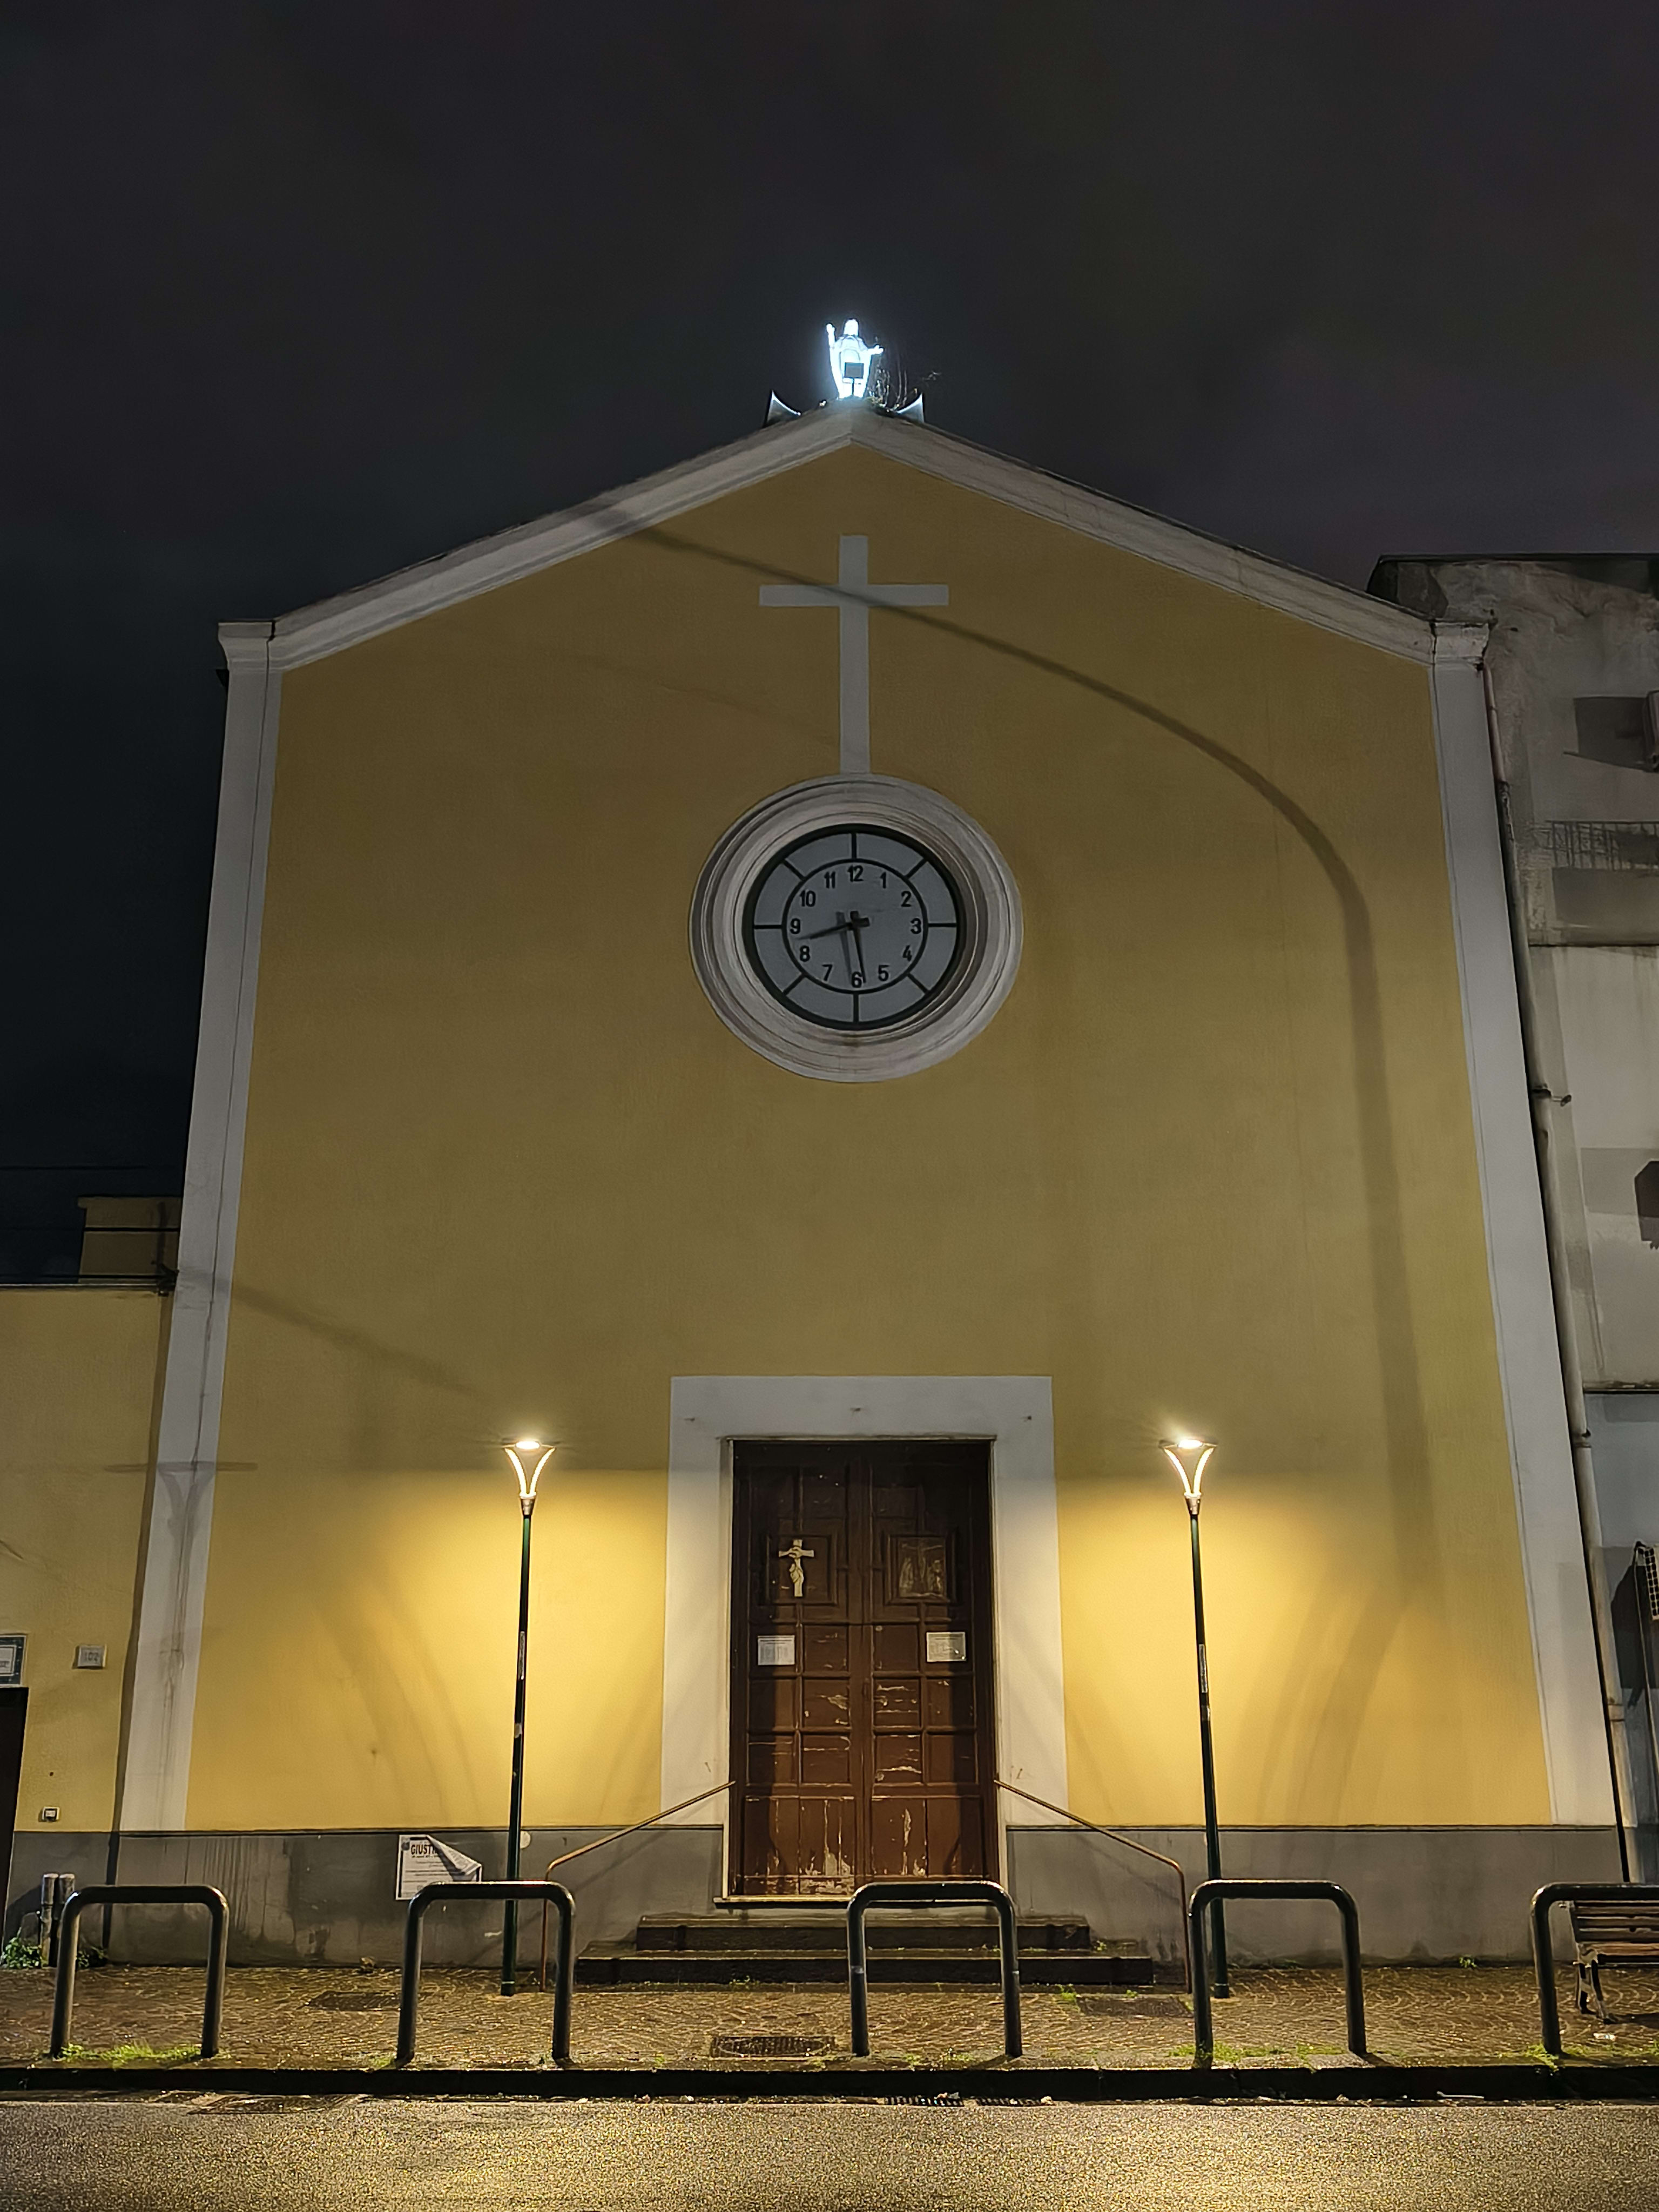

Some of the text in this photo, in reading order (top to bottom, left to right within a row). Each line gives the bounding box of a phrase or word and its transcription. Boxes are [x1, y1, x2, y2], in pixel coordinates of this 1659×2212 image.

[824, 871, 836, 889] 11
[848, 865, 864, 882] 12
[880, 872, 887, 889] 1
[799, 890, 816, 907] 10
[901, 891, 912, 907] 2
[790, 918, 801, 934] 9
[911, 918, 922, 934] 3
[800, 945, 811, 962] 8
[903, 945, 912, 962] 4
[822, 965, 833, 981] 7
[852, 972, 862, 988] 6
[878, 965, 889, 982] 5
